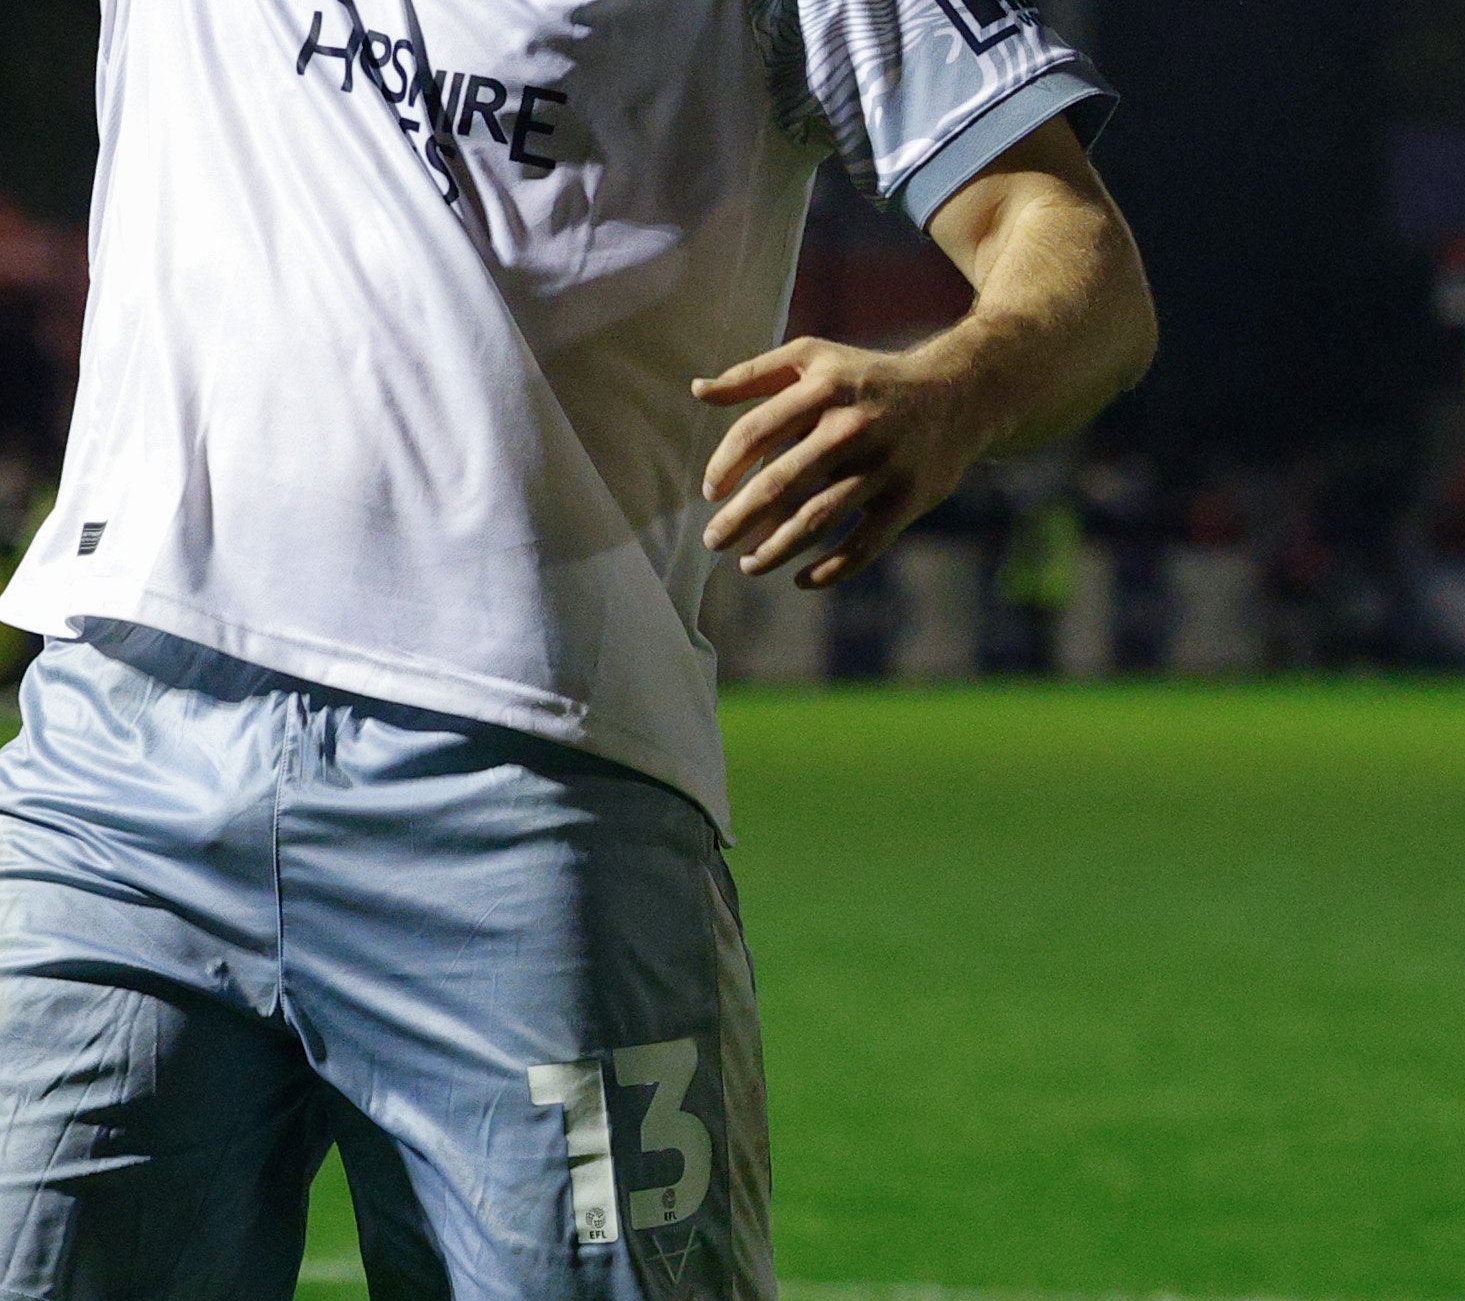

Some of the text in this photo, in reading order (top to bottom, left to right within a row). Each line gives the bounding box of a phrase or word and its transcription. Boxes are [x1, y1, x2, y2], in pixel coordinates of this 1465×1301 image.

[527, 1037, 713, 1244] 13
[662, 1210, 678, 1222] EFL
[589, 1229, 608, 1240] EFL
